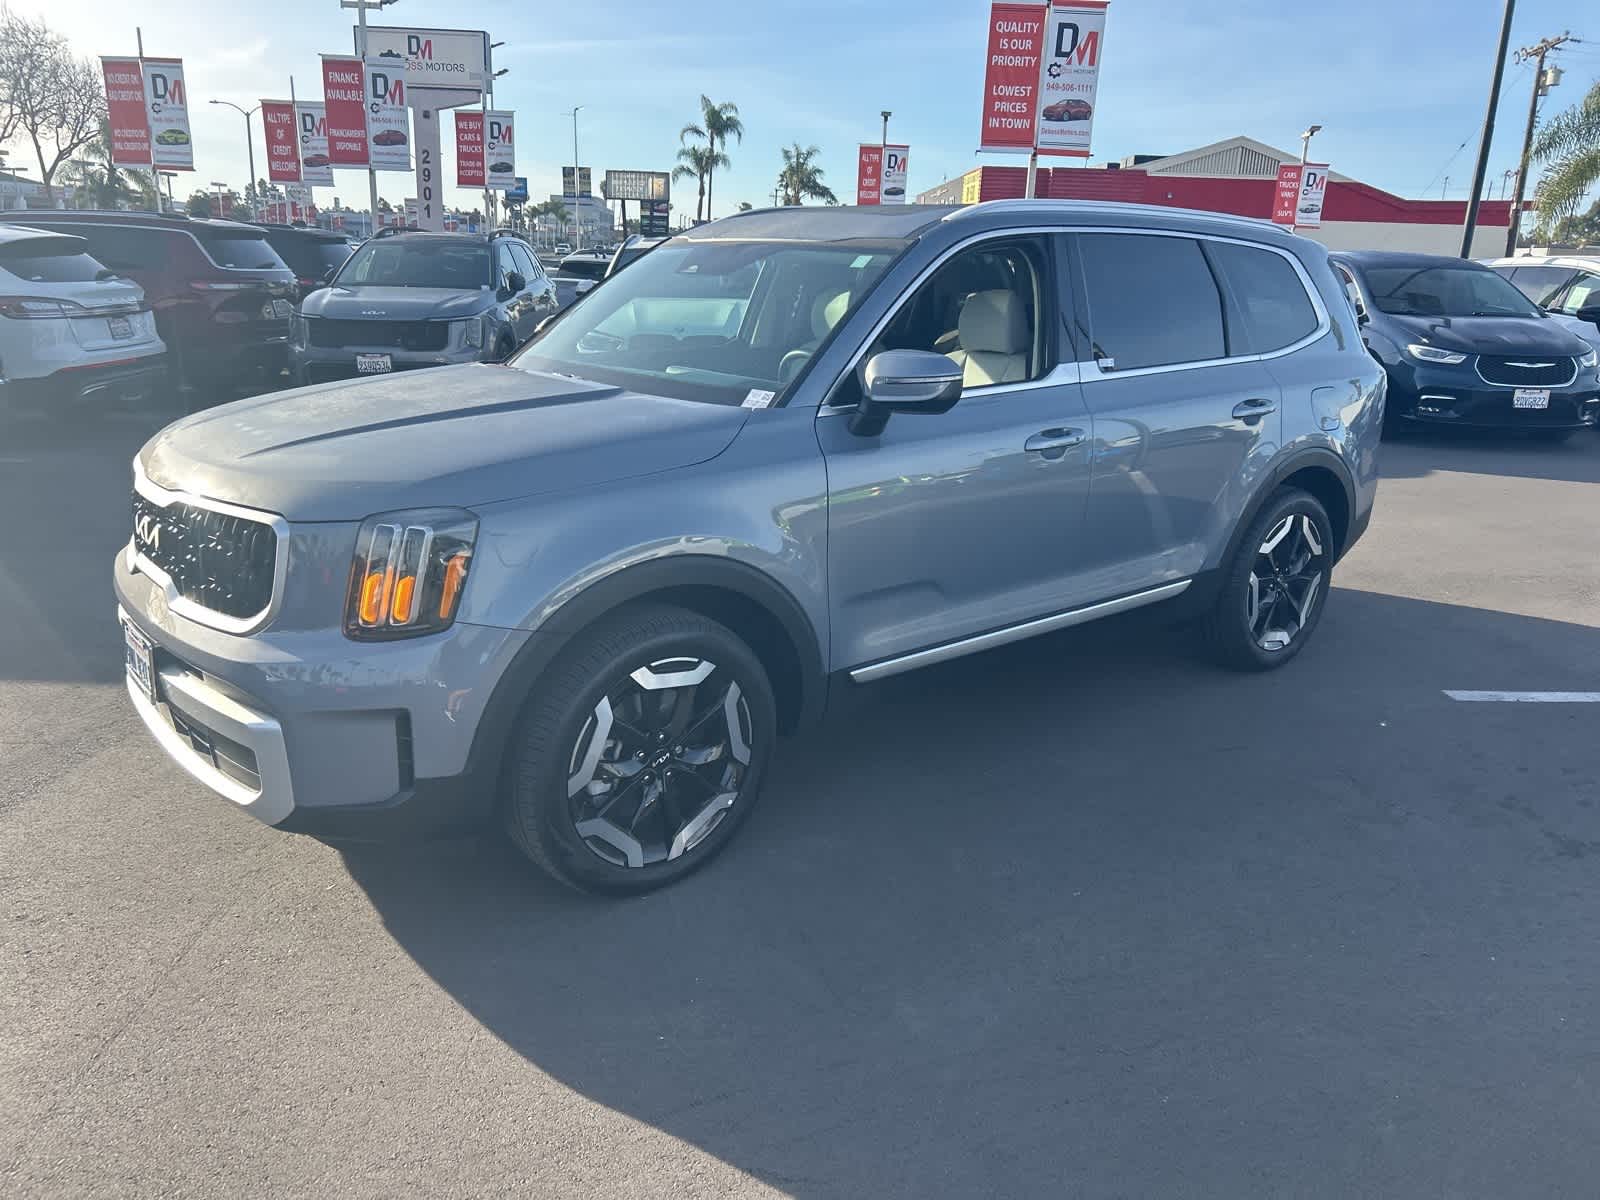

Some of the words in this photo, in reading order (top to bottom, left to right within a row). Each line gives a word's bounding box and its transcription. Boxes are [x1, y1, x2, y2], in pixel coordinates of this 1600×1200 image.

[996, 21, 1039, 33] QUALITY
[408, 35, 432, 60] DM
[1000, 39, 1009, 49] IS
[1010, 39, 1032, 50] OUR
[1055, 22, 1099, 67] DM
[425, 62, 465, 72] MOTORS
[992, 56, 1037, 67] PRIORITY
[329, 71, 360, 84] FINANCE
[151, 74, 184, 105] DM
[327, 88, 363, 102] AVAILABLE
[372, 73, 404, 106] DM
[993, 85, 1032, 97] LOWEST
[994, 102, 1028, 113] PRICES
[267, 112, 277, 123] ALL
[277, 112, 291, 124] TYPE
[989, 117, 1000, 128] IN
[1000, 118, 1031, 129] TOWN
[458, 121, 469, 129] WE
[469, 122, 481, 130] BUY
[459, 133, 475, 141] CARS
[272, 145, 292, 156] CREDIT
[459, 145, 482, 153] TRUCKS
[272, 161, 296, 172] WELCOME
[422, 150, 431, 218] 2901
[1280, 181, 1299, 189] TRUCKS
